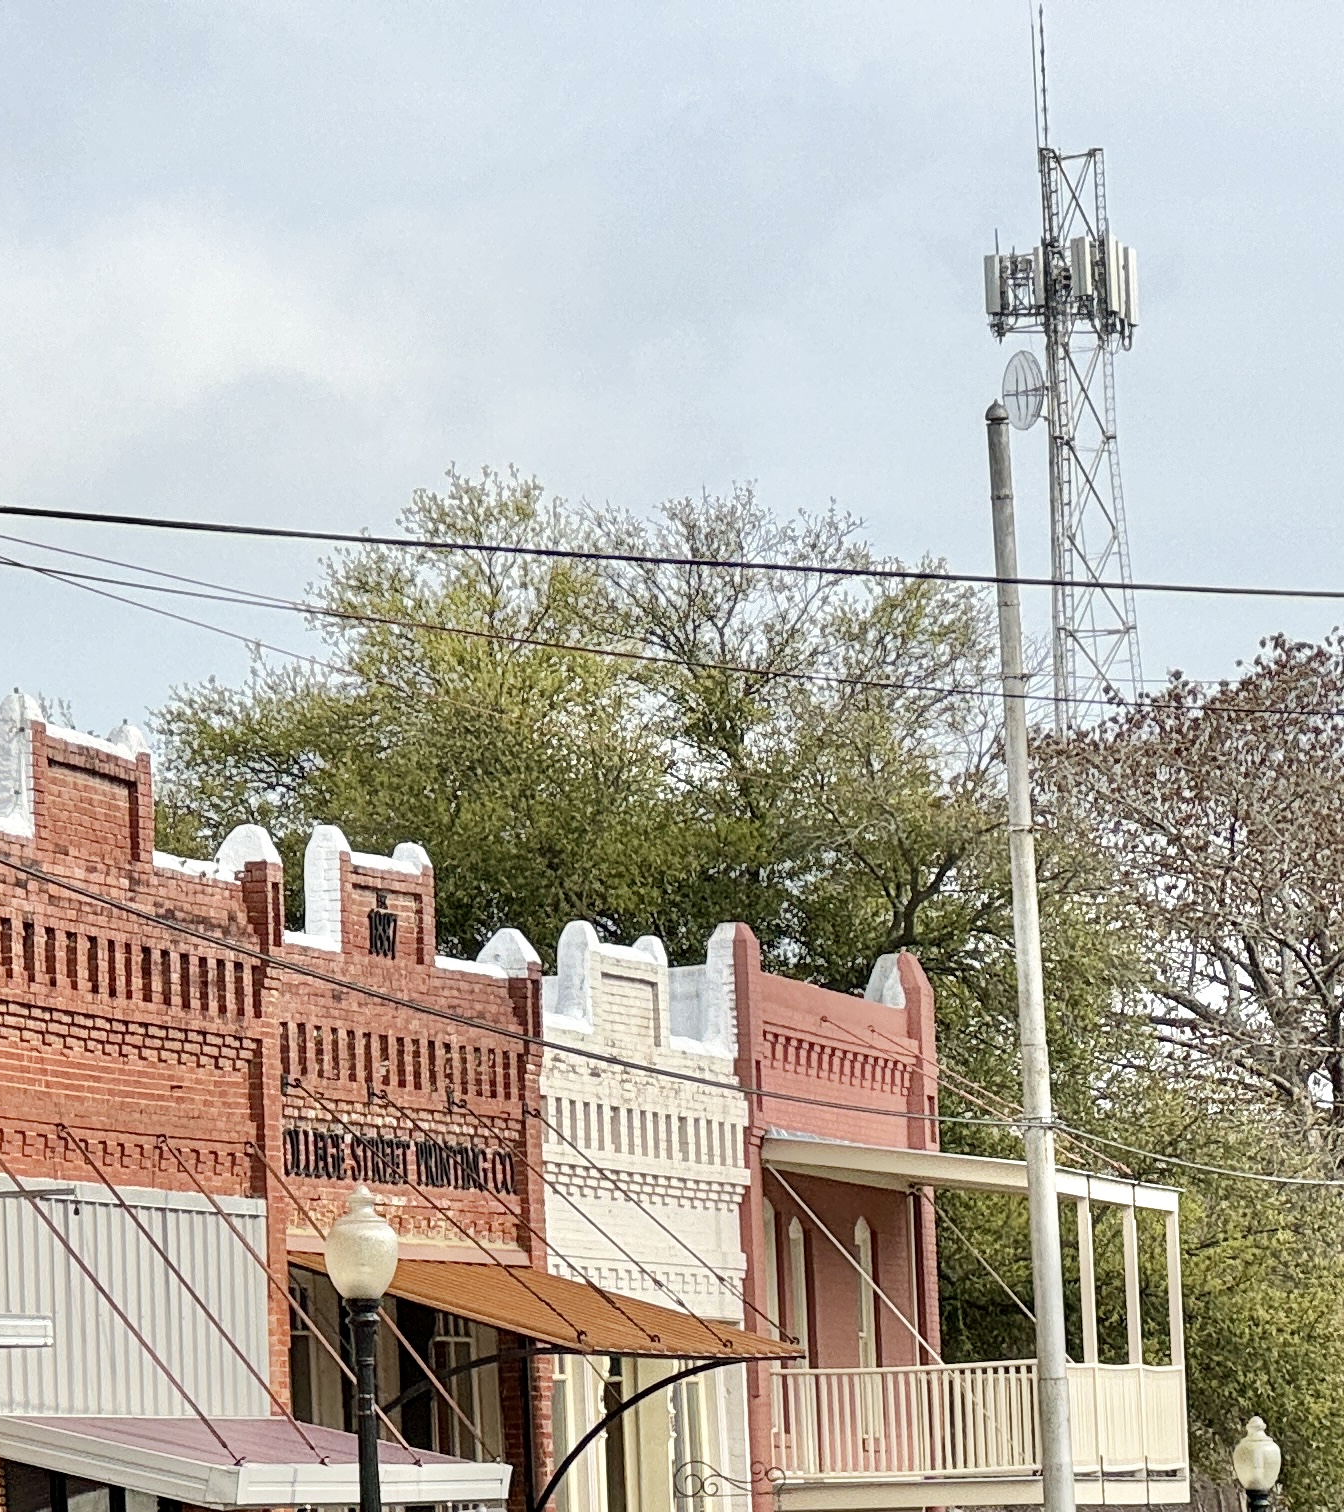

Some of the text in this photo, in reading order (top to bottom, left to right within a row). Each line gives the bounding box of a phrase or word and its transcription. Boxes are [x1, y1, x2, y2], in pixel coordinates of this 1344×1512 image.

[283, 1127, 346, 1181] OLLEGE
[350, 1134, 410, 1185] STREET
[415, 1140, 488, 1193] PRINTING
